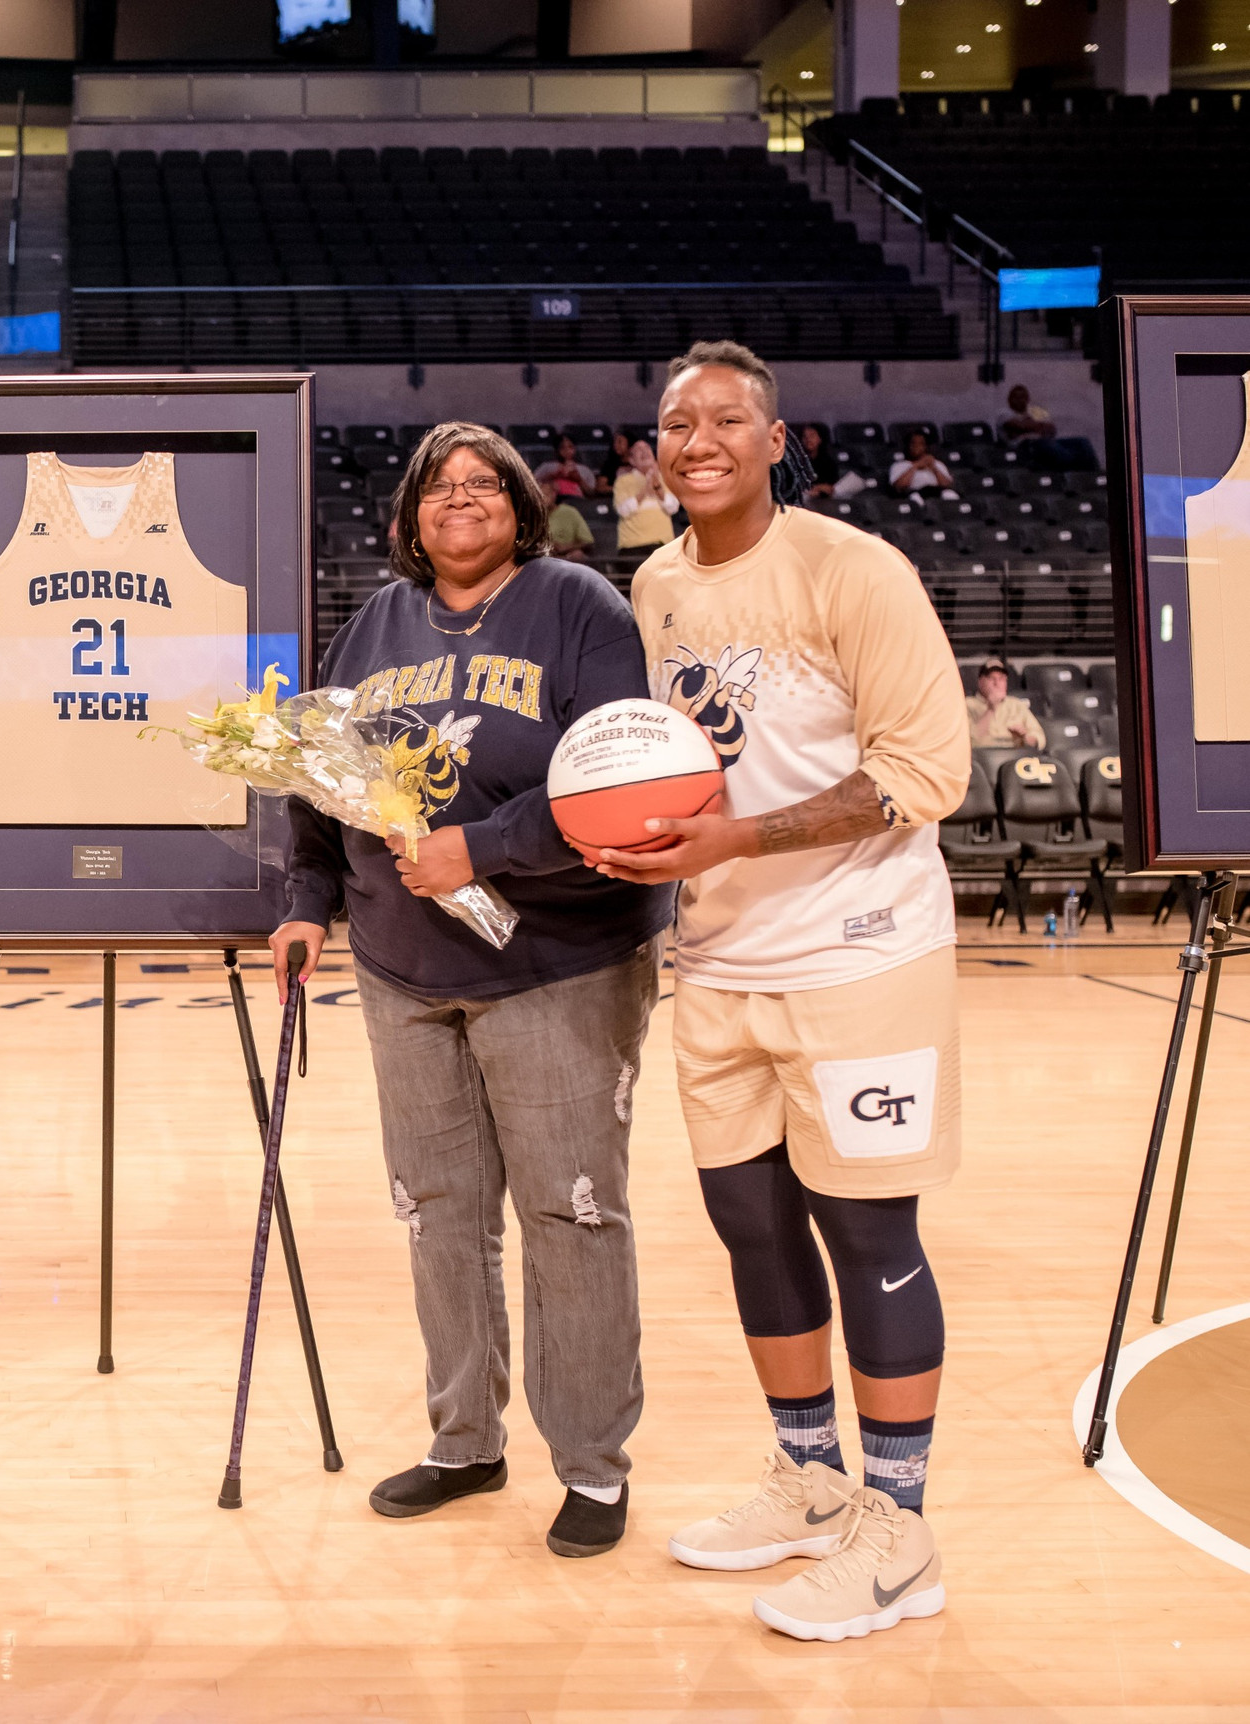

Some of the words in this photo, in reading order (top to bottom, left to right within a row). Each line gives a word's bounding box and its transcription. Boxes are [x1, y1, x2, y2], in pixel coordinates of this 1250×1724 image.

[145, 524, 169, 533] ACC
[29, 570, 172, 609] GEORGIA
[72, 618, 130, 676] 21
[464, 654, 543, 721] TECH
[53, 691, 149, 721] TECH
[607, 711, 668, 724] O'Neil
[580, 727, 624, 748] CAREER
[627, 727, 670, 743] POINTS
[850, 1085, 915, 1126] GT
